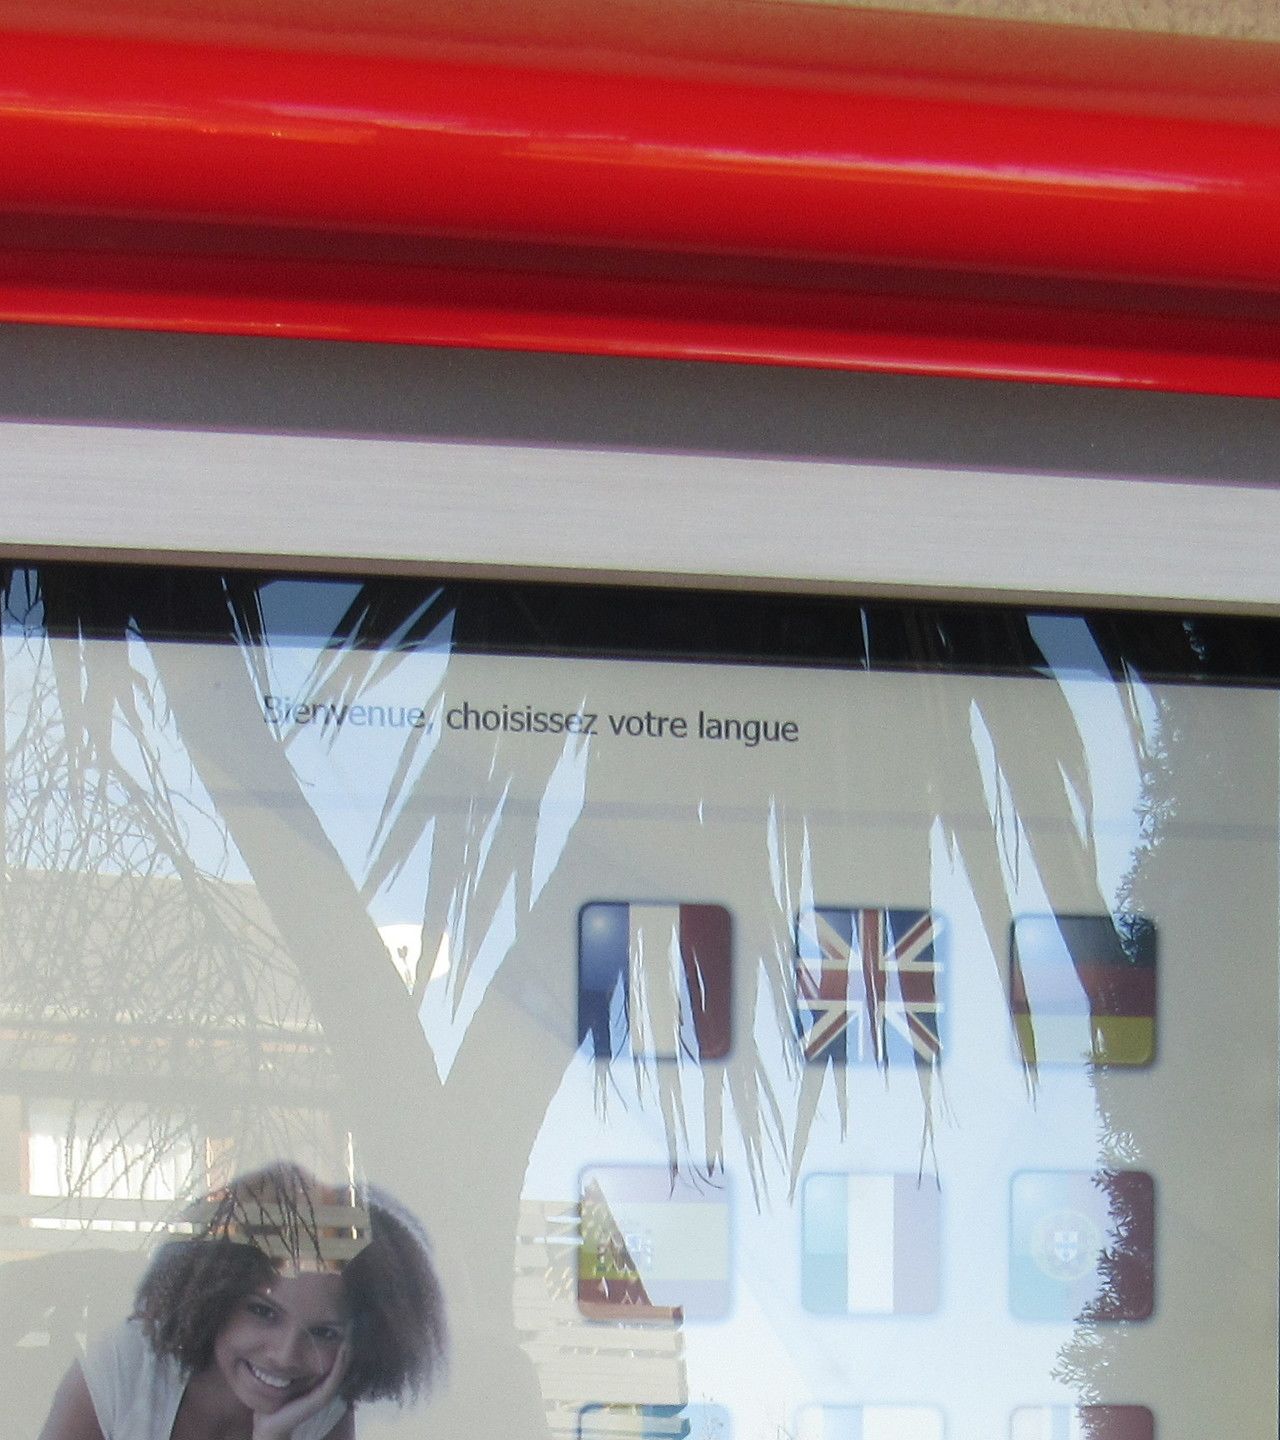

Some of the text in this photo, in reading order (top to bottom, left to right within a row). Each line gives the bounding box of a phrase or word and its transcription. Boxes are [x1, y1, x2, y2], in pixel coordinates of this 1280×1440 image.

[263, 696, 800, 748] Bienvenue, choisissez votre langue
